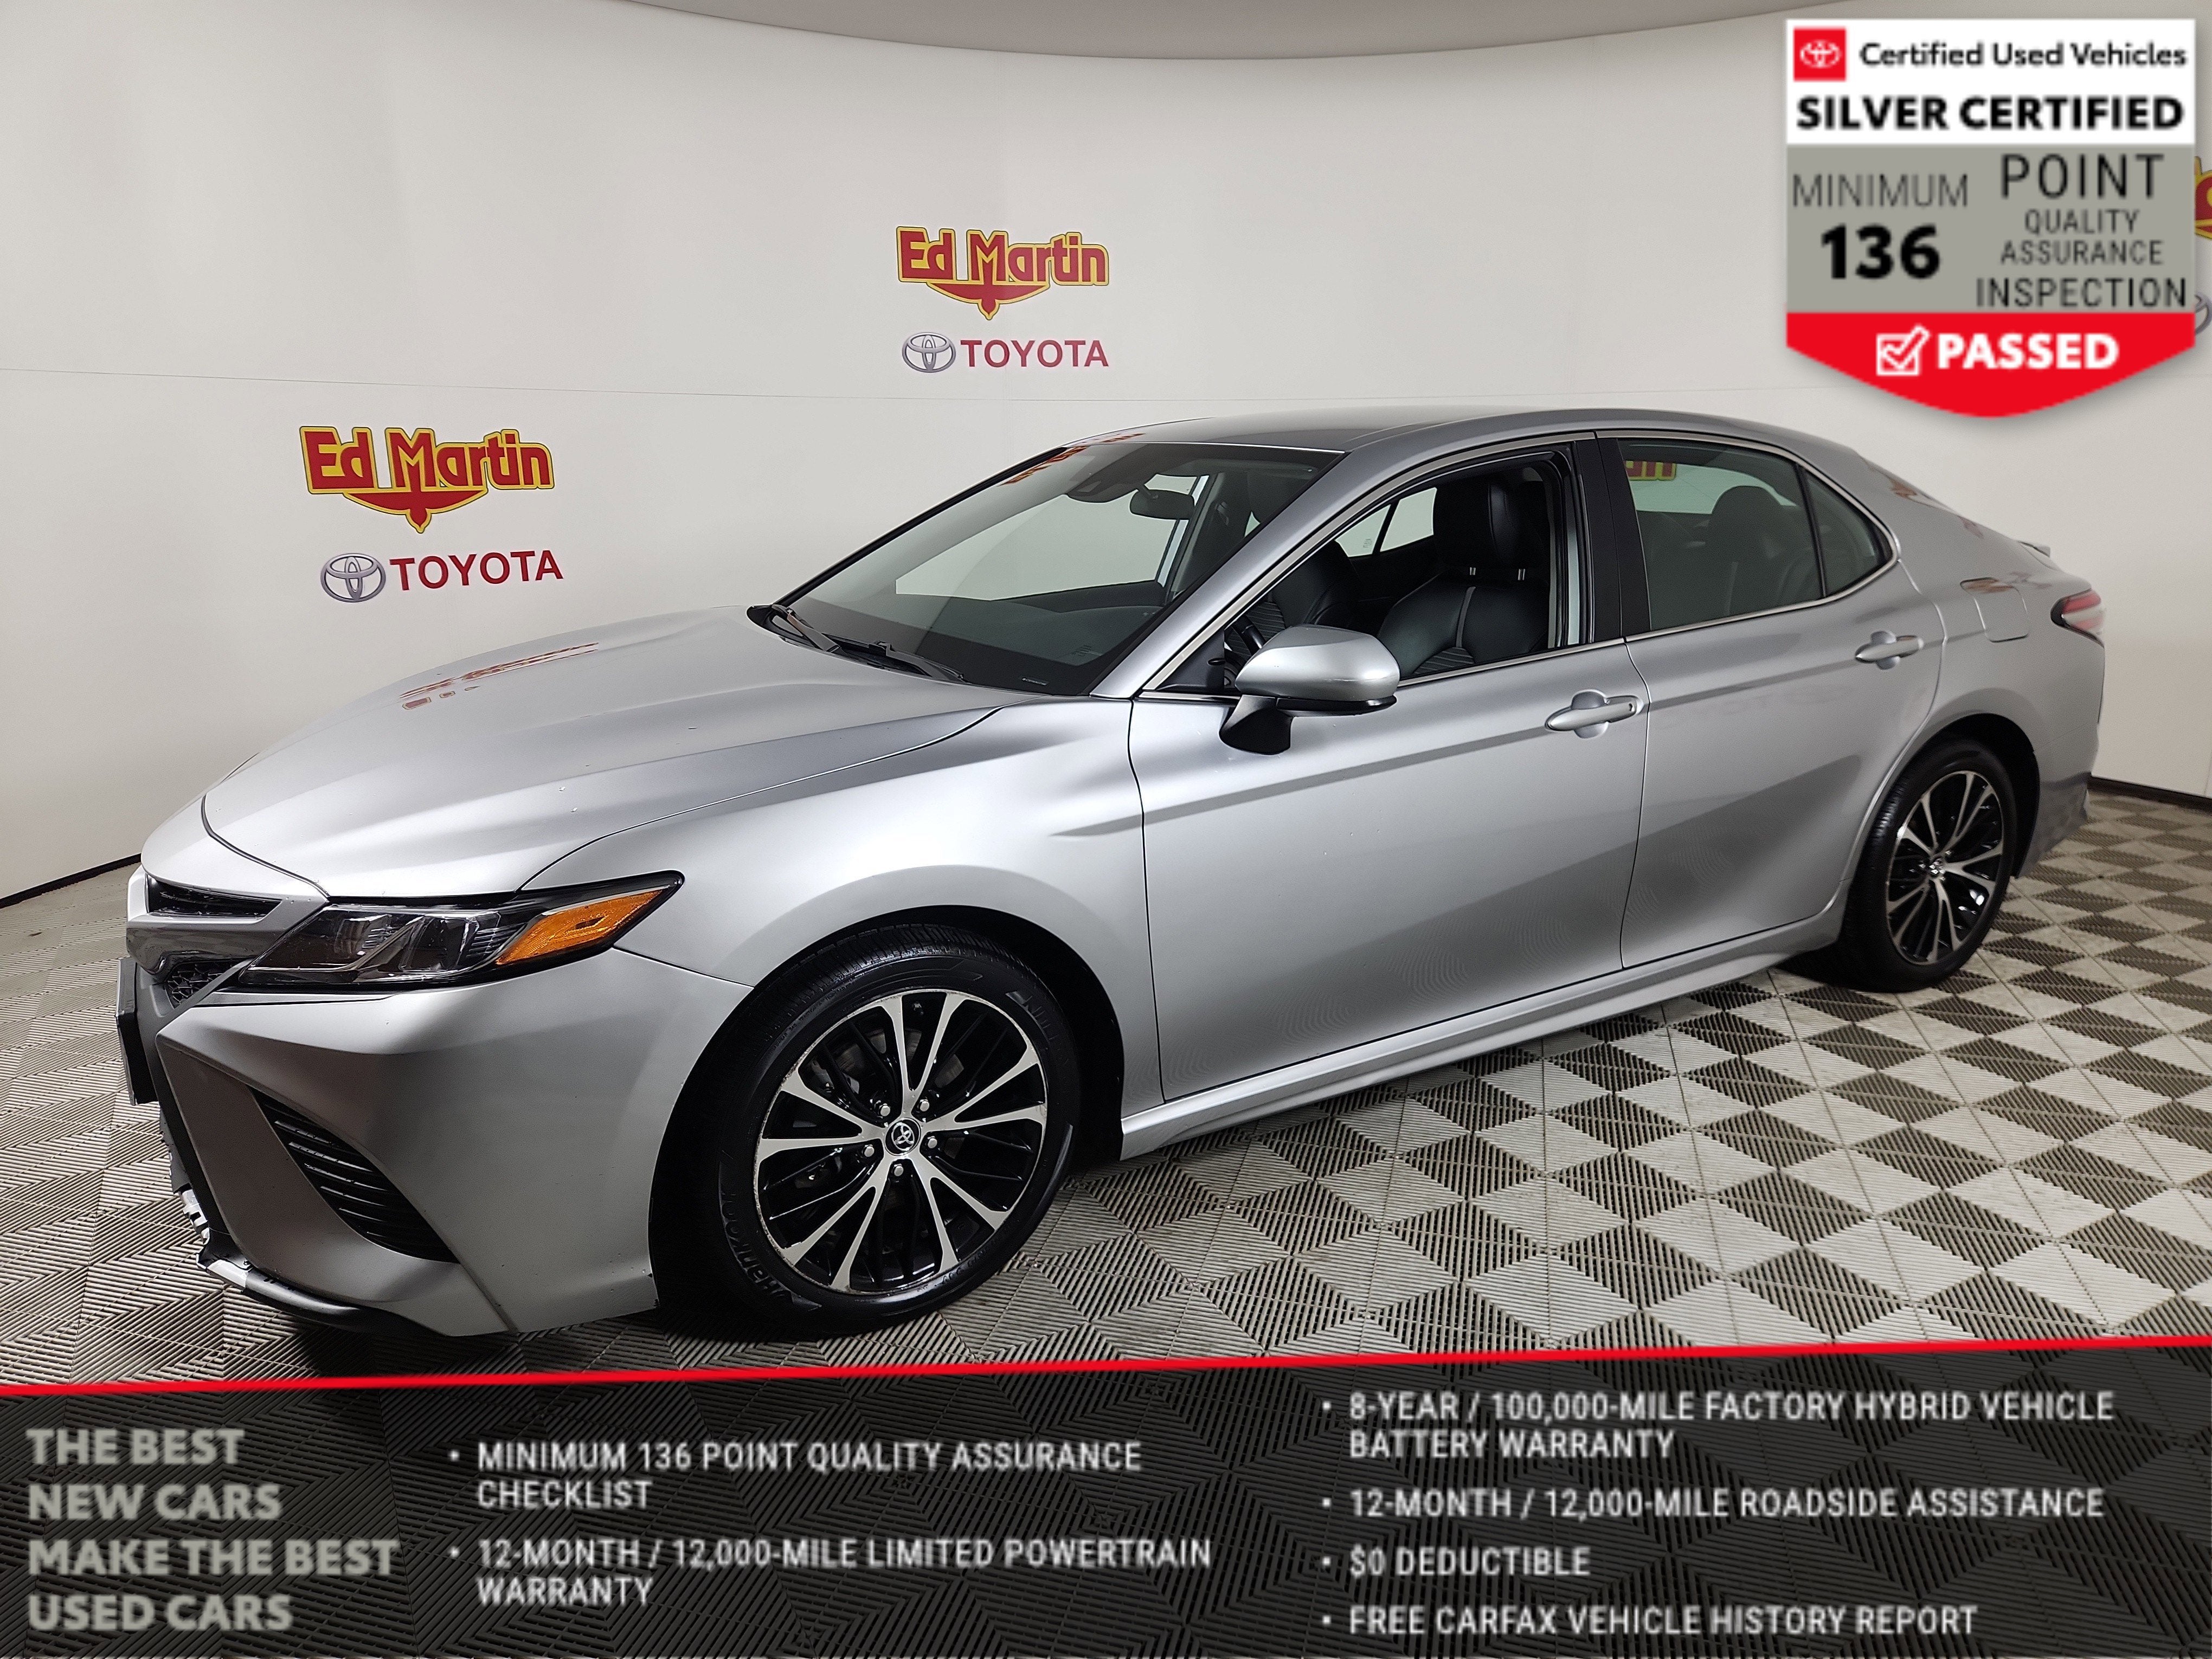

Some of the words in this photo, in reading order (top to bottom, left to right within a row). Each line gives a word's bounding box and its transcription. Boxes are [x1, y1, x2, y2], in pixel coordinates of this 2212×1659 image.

[896, 226, 956, 283] Ed
[966, 229, 1109, 292] Martin
[960, 339, 1109, 368] TOYOTA
[300, 426, 377, 494] Ed
[385, 427, 555, 496] Martin
[389, 549, 564, 591] TOYOTA
